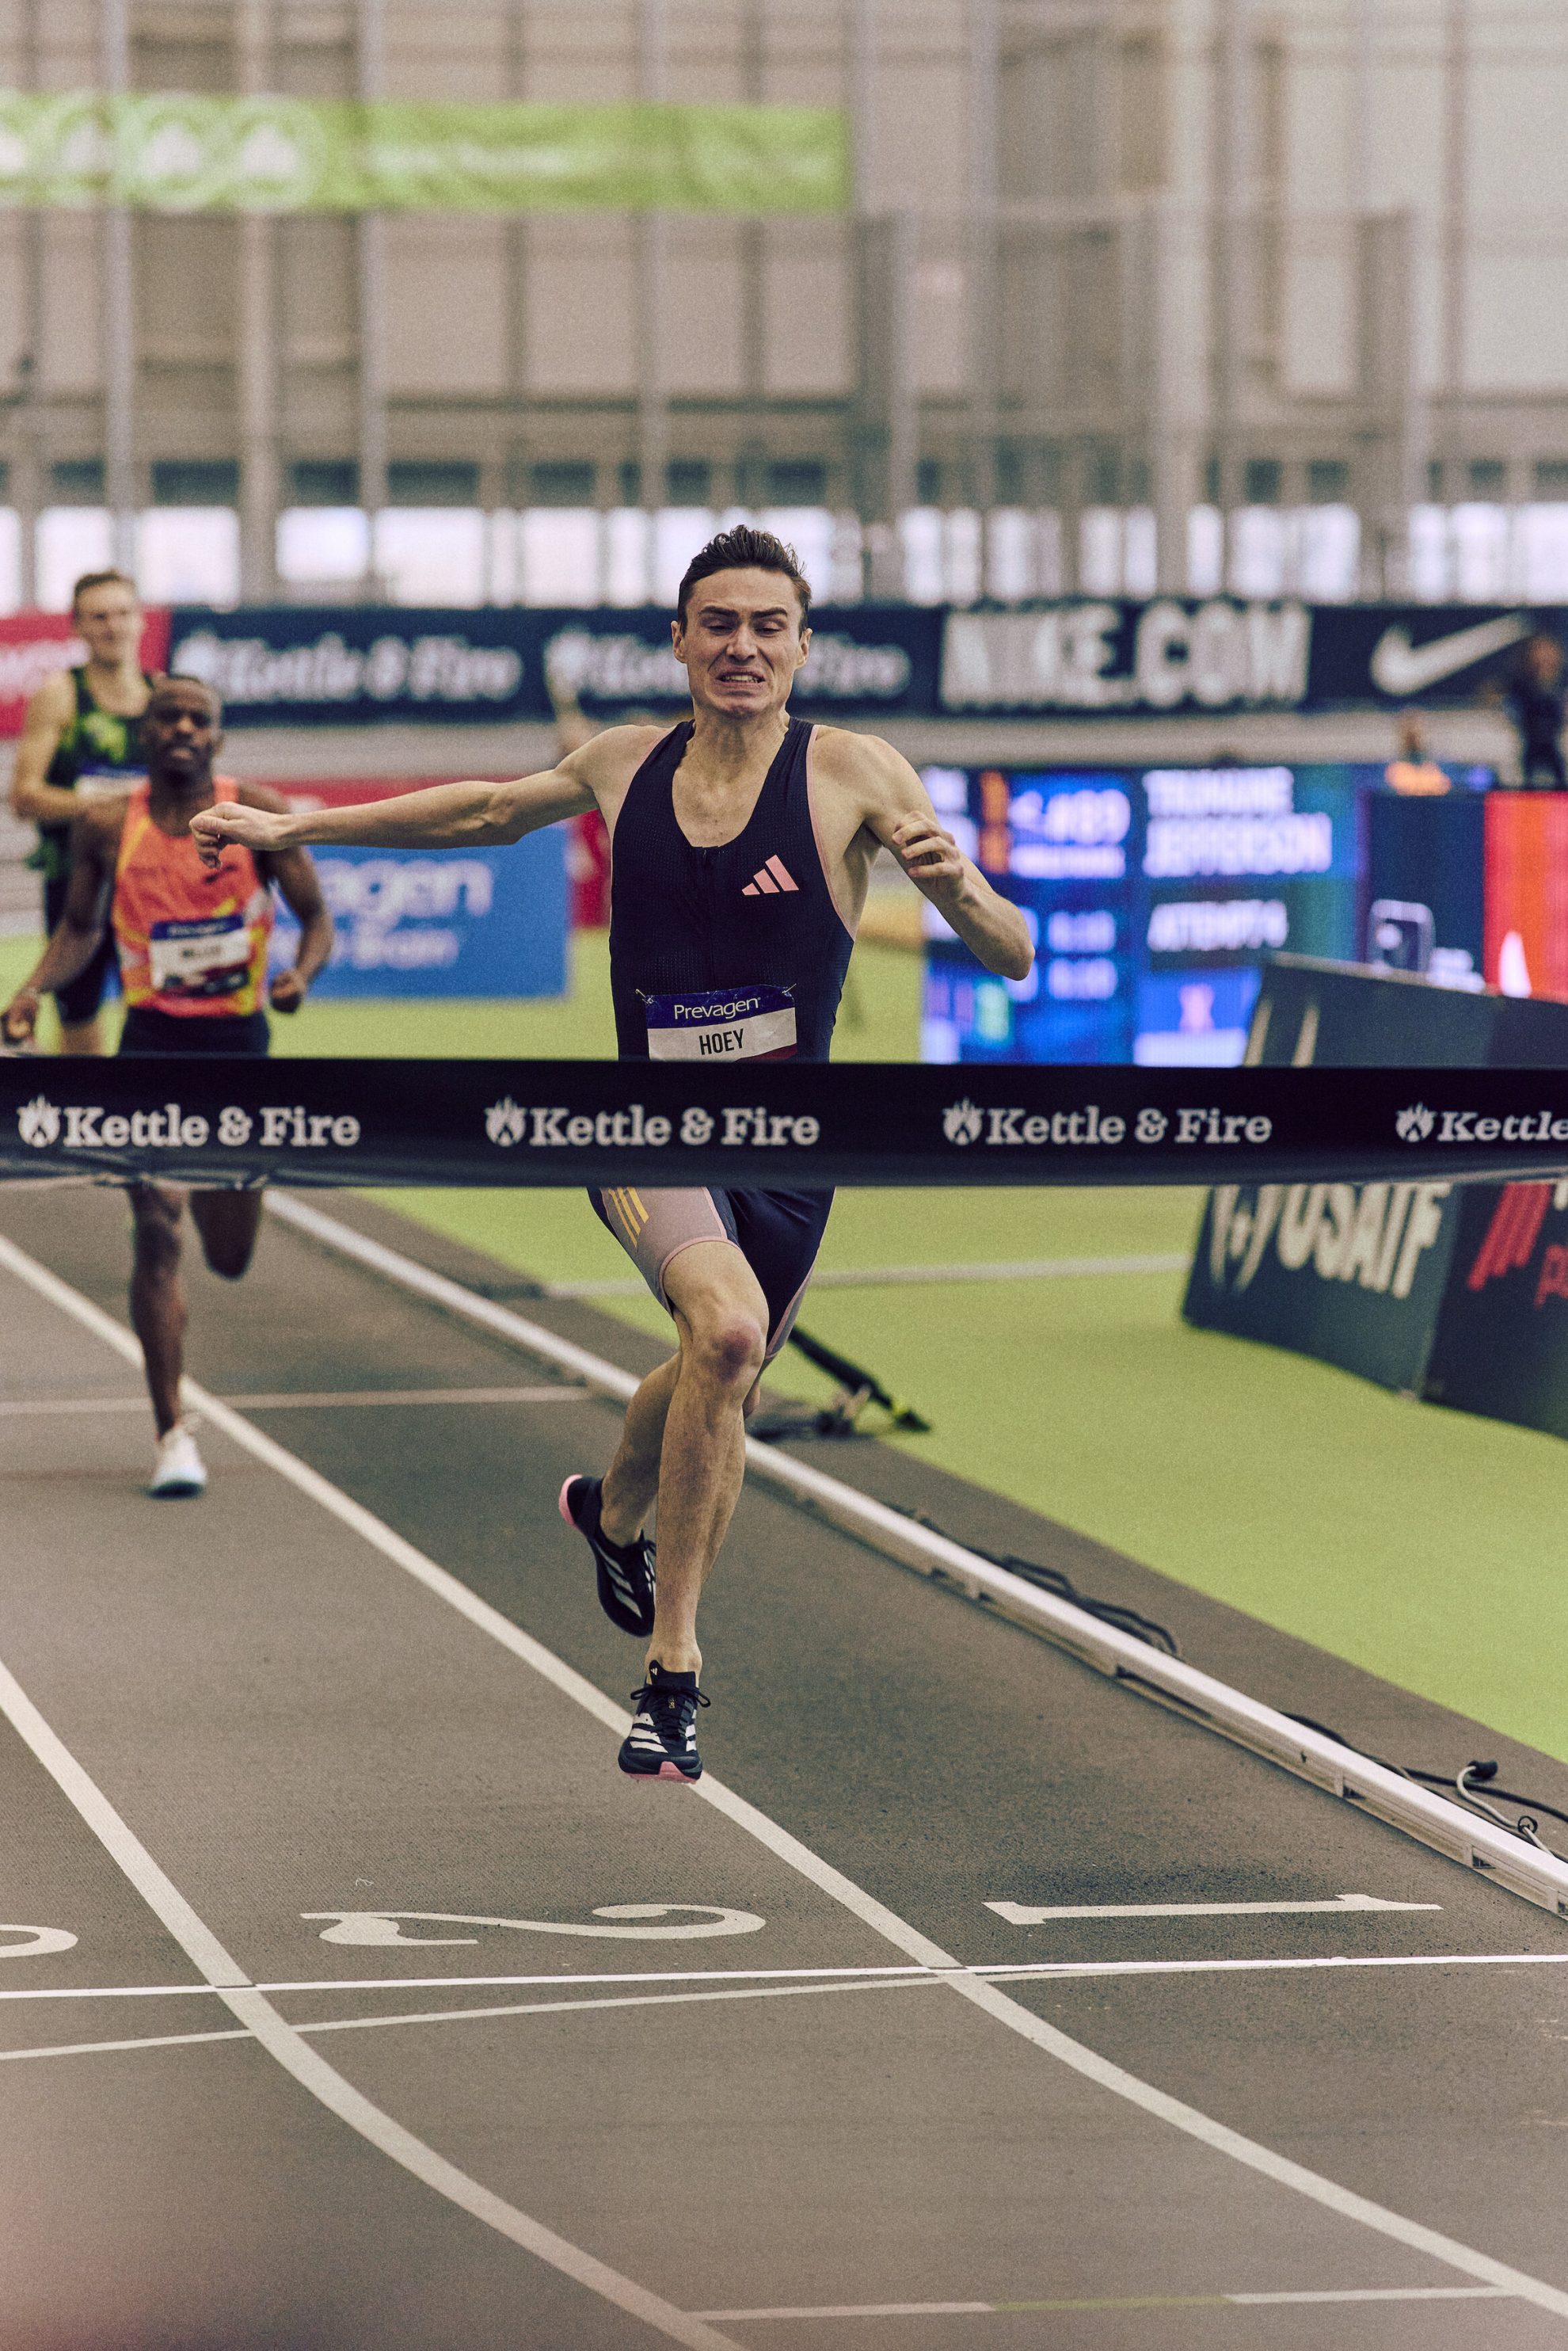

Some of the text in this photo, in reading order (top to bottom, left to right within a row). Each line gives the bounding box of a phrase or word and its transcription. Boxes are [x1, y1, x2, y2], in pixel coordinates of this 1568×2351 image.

[940, 605, 1311, 707] NIKE.COM
[674, 996, 759, 1020] Prevagen
[699, 1028, 744, 1056] HOEY
[63, 1103, 360, 1147] Kettle & Fire
[530, 1104, 820, 1146] Kettle & Fire
[986, 1105, 1272, 1144] Kettle & Fire
